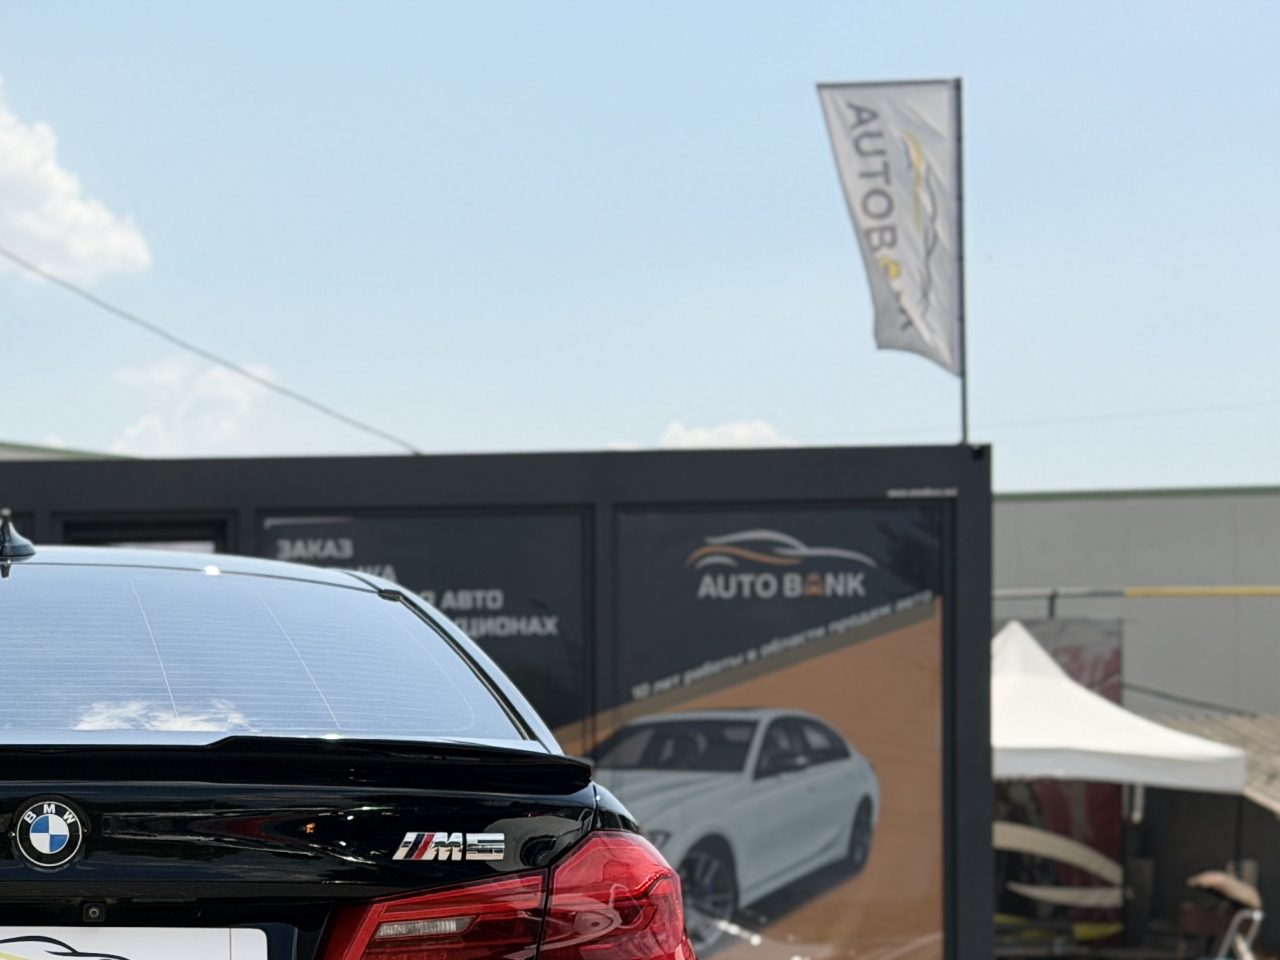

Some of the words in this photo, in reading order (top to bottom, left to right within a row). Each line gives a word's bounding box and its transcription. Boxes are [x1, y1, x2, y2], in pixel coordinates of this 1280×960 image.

[277, 538, 354, 560] ЗАКАЗ
[697, 572, 778, 599] AUTO
[440, 588, 504, 611] АВТО
[23, 803, 77, 825] BMW
[392, 831, 506, 861] M5
